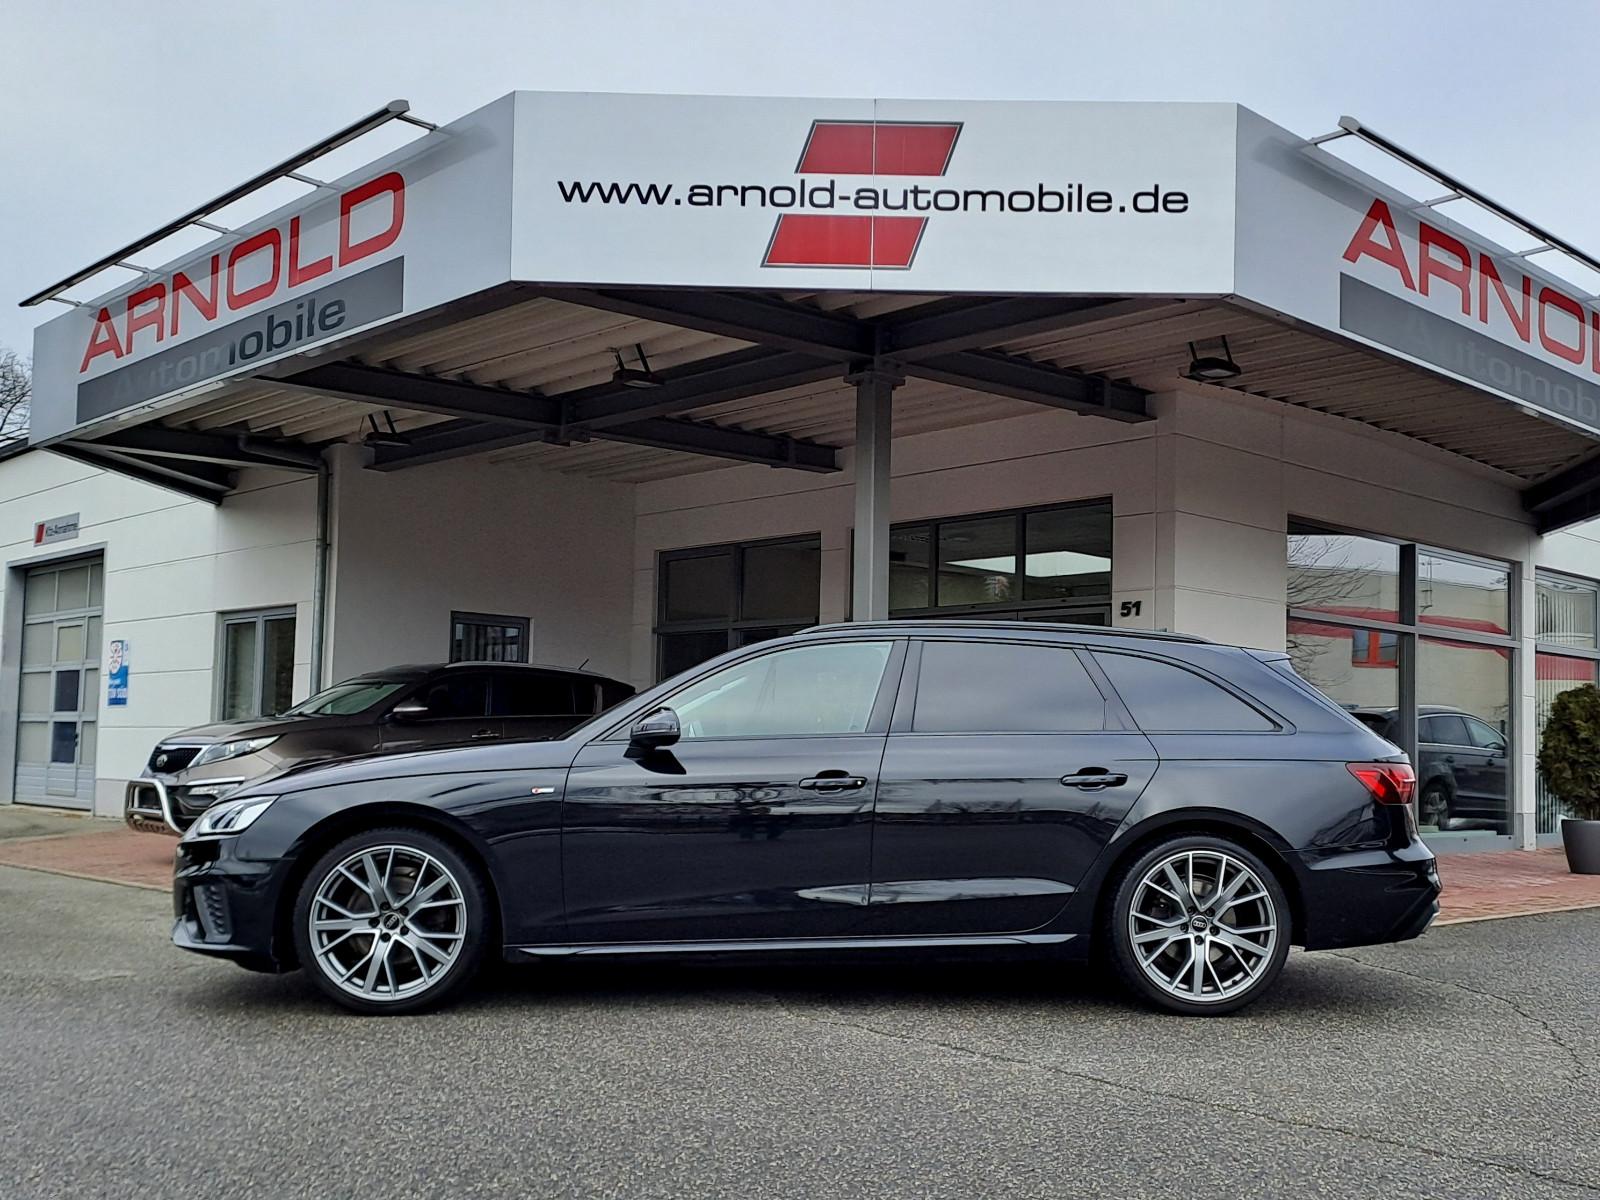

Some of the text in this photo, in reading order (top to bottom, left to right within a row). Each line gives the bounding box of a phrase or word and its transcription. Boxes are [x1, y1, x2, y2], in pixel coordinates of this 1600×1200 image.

[557, 179, 1189, 214] www.arnold-automobile.de
[79, 171, 405, 373] ARNOLD
[1342, 198, 1600, 374] ARNO
[112, 297, 346, 398] Automobile
[1120, 600, 1142, 617] 51
